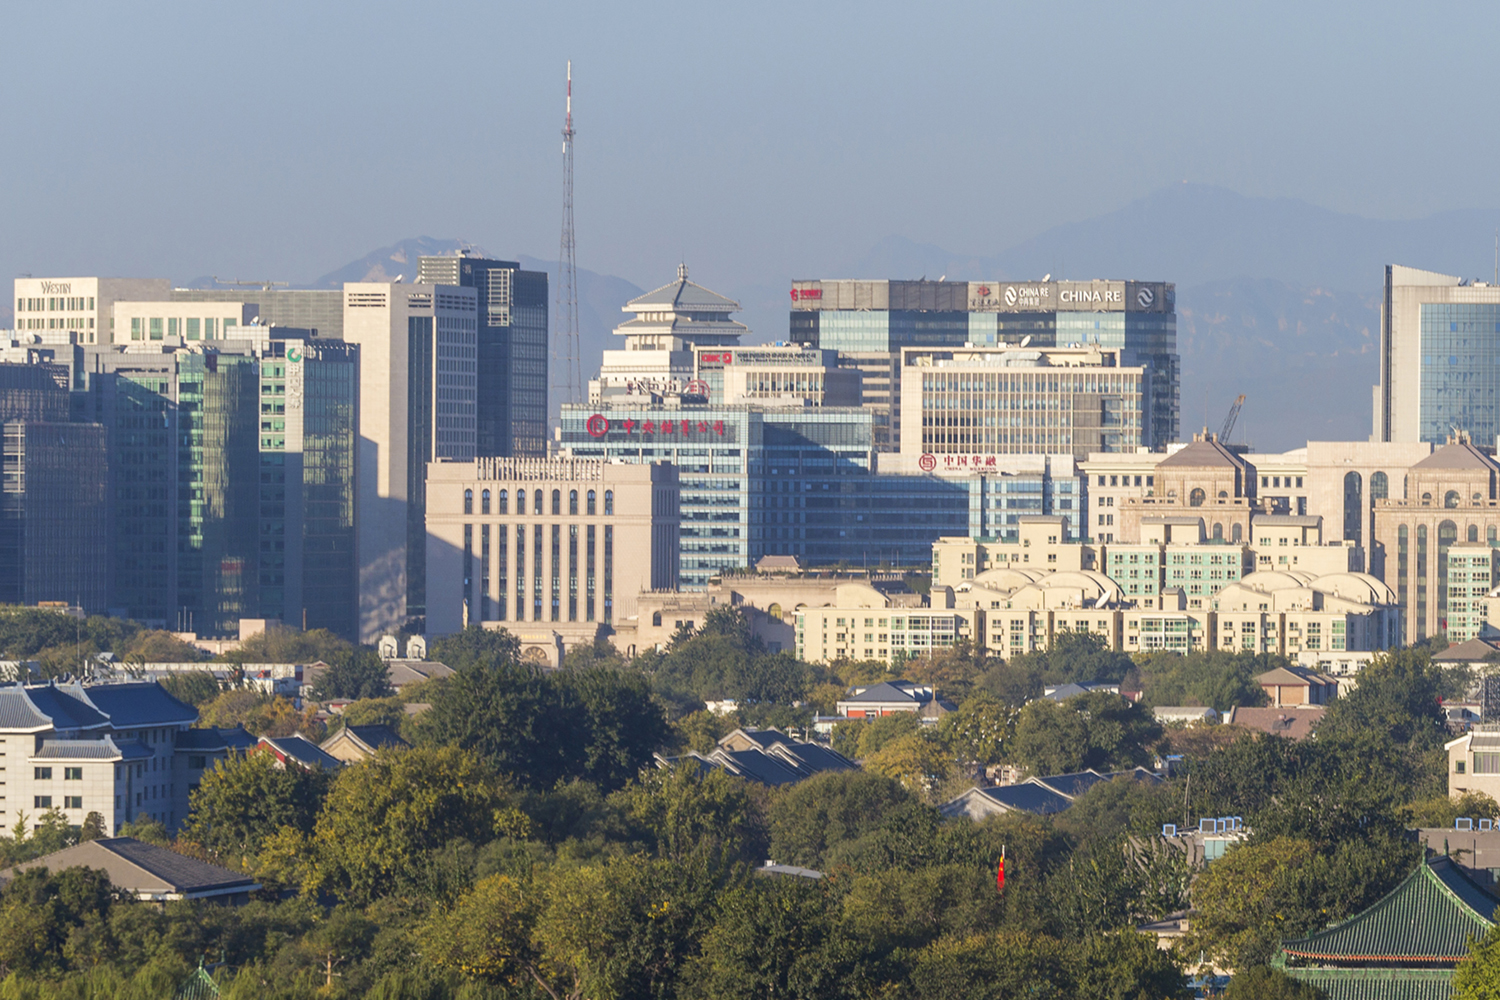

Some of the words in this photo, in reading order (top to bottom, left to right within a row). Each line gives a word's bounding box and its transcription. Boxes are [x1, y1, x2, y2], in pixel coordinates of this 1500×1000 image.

[1018, 287, 1039, 297] CHINA
[1040, 287, 1049, 297] RE
[1060, 290, 1102, 302] CHINA
[1105, 290, 1121, 302] RE
[944, 455, 997, 466] 中国华融
